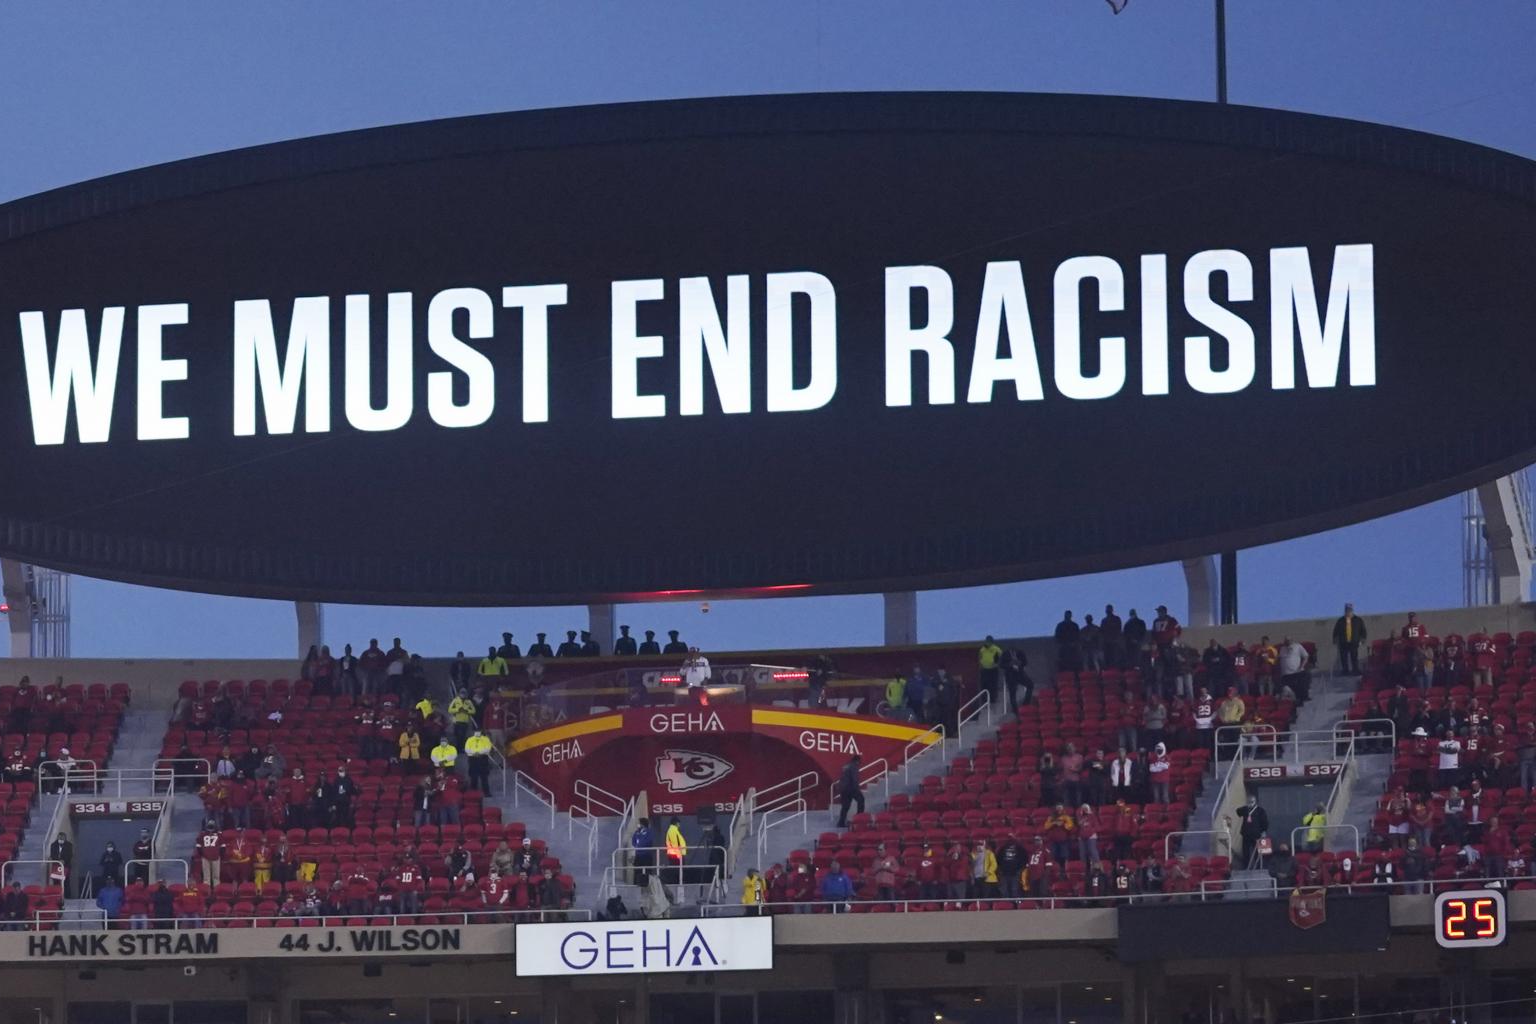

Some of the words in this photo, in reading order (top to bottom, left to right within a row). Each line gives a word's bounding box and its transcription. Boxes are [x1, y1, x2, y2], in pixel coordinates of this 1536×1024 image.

[19, 303, 189, 446] WE
[234, 283, 567, 436] MUST
[610, 271, 837, 419] END
[884, 243, 1377, 406] RACISM
[1409, 628, 1419, 637] 15
[650, 711, 724, 732] GEHA
[800, 731, 859, 753] GEHA
[542, 739, 583, 765] GEHA
[1249, 767, 1282, 777] 336
[1309, 765, 1342, 775] 337
[75, 803, 105, 813] 334
[132, 802, 161, 812] 335
[653, 804, 683, 813] 335
[203, 836, 218, 847] 87
[402, 872, 412, 883] 10
[489, 883, 497, 895] 3
[1446, 900, 1495, 938] 25
[28, 934, 110, 957] HANK
[118, 932, 219, 956] STRAM
[279, 932, 312, 953] 44
[350, 928, 461, 952] WILSON
[560, 925, 718, 969] GEHA
